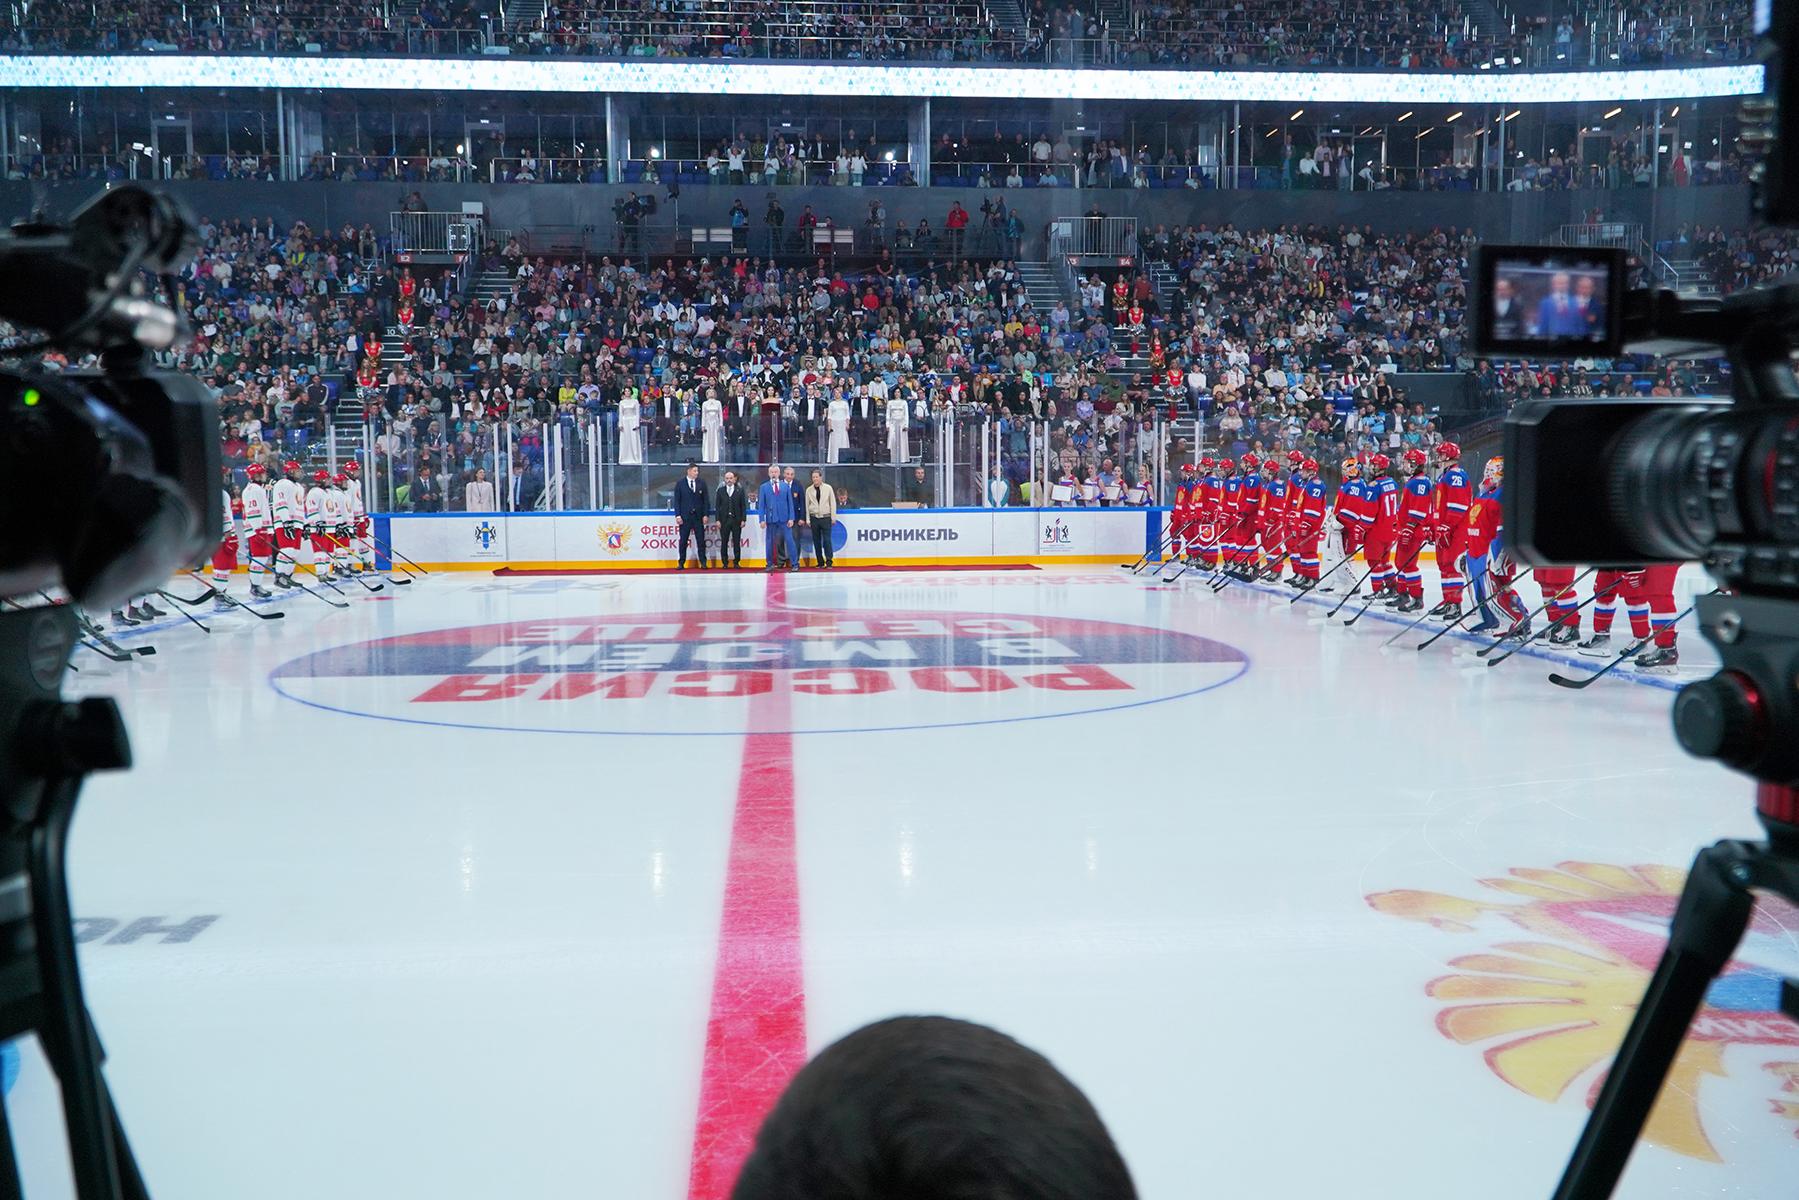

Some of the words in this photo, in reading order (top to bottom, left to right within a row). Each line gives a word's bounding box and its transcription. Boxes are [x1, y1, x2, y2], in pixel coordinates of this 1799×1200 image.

[1249, 479, 1255, 487] 7
[1451, 475, 1463, 486] 26
[1276, 488, 1284, 496] 25
[1312, 488, 1321, 497] 27
[1350, 486, 1360, 496] 30
[1417, 484, 1426, 495] 19
[1385, 493, 1397, 517] 17
[857, 529, 959, 541] НОРНИКЕЛЬ
[641, 538, 693, 549] ХОККЯ
[509, 619, 1042, 641] СЕРДЦЕ
[976, 637, 1082, 658] В
[410, 664, 1136, 703] РОССИЯ
